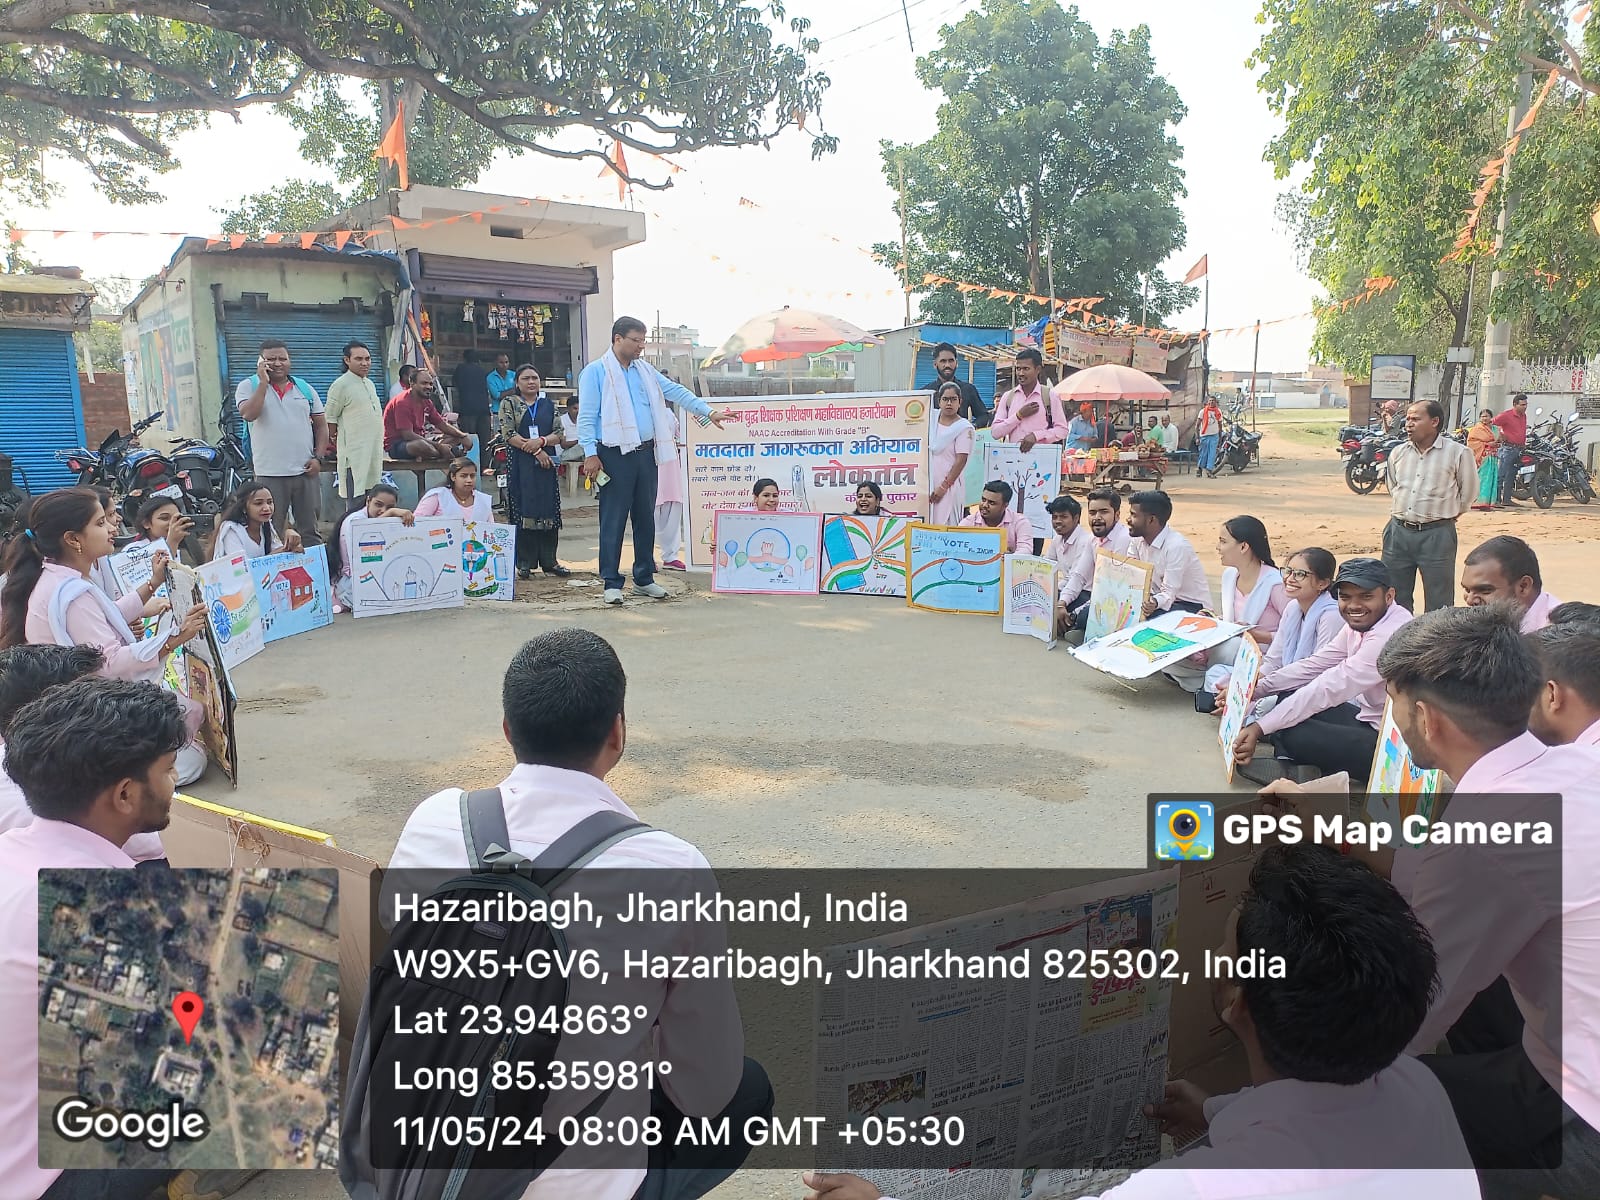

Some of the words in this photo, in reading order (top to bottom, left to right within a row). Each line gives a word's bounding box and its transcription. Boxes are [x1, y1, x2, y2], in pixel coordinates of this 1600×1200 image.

[760, 406, 783, 423] शिक्षक
[815, 403, 857, 421] महाविद्यालय
[749, 429, 769, 437] NAAC
[771, 428, 816, 437] Accreditation
[818, 427, 833, 435] With
[835, 427, 856, 435] Grade
[695, 442, 755, 458] मतदाता
[760, 441, 844, 457] जागरूकता
[850, 434, 921, 455] अभियान
[812, 457, 919, 487] लोकतंत्र
[887, 493, 917, 504] पुकार
[943, 540, 970, 548] VOTE
